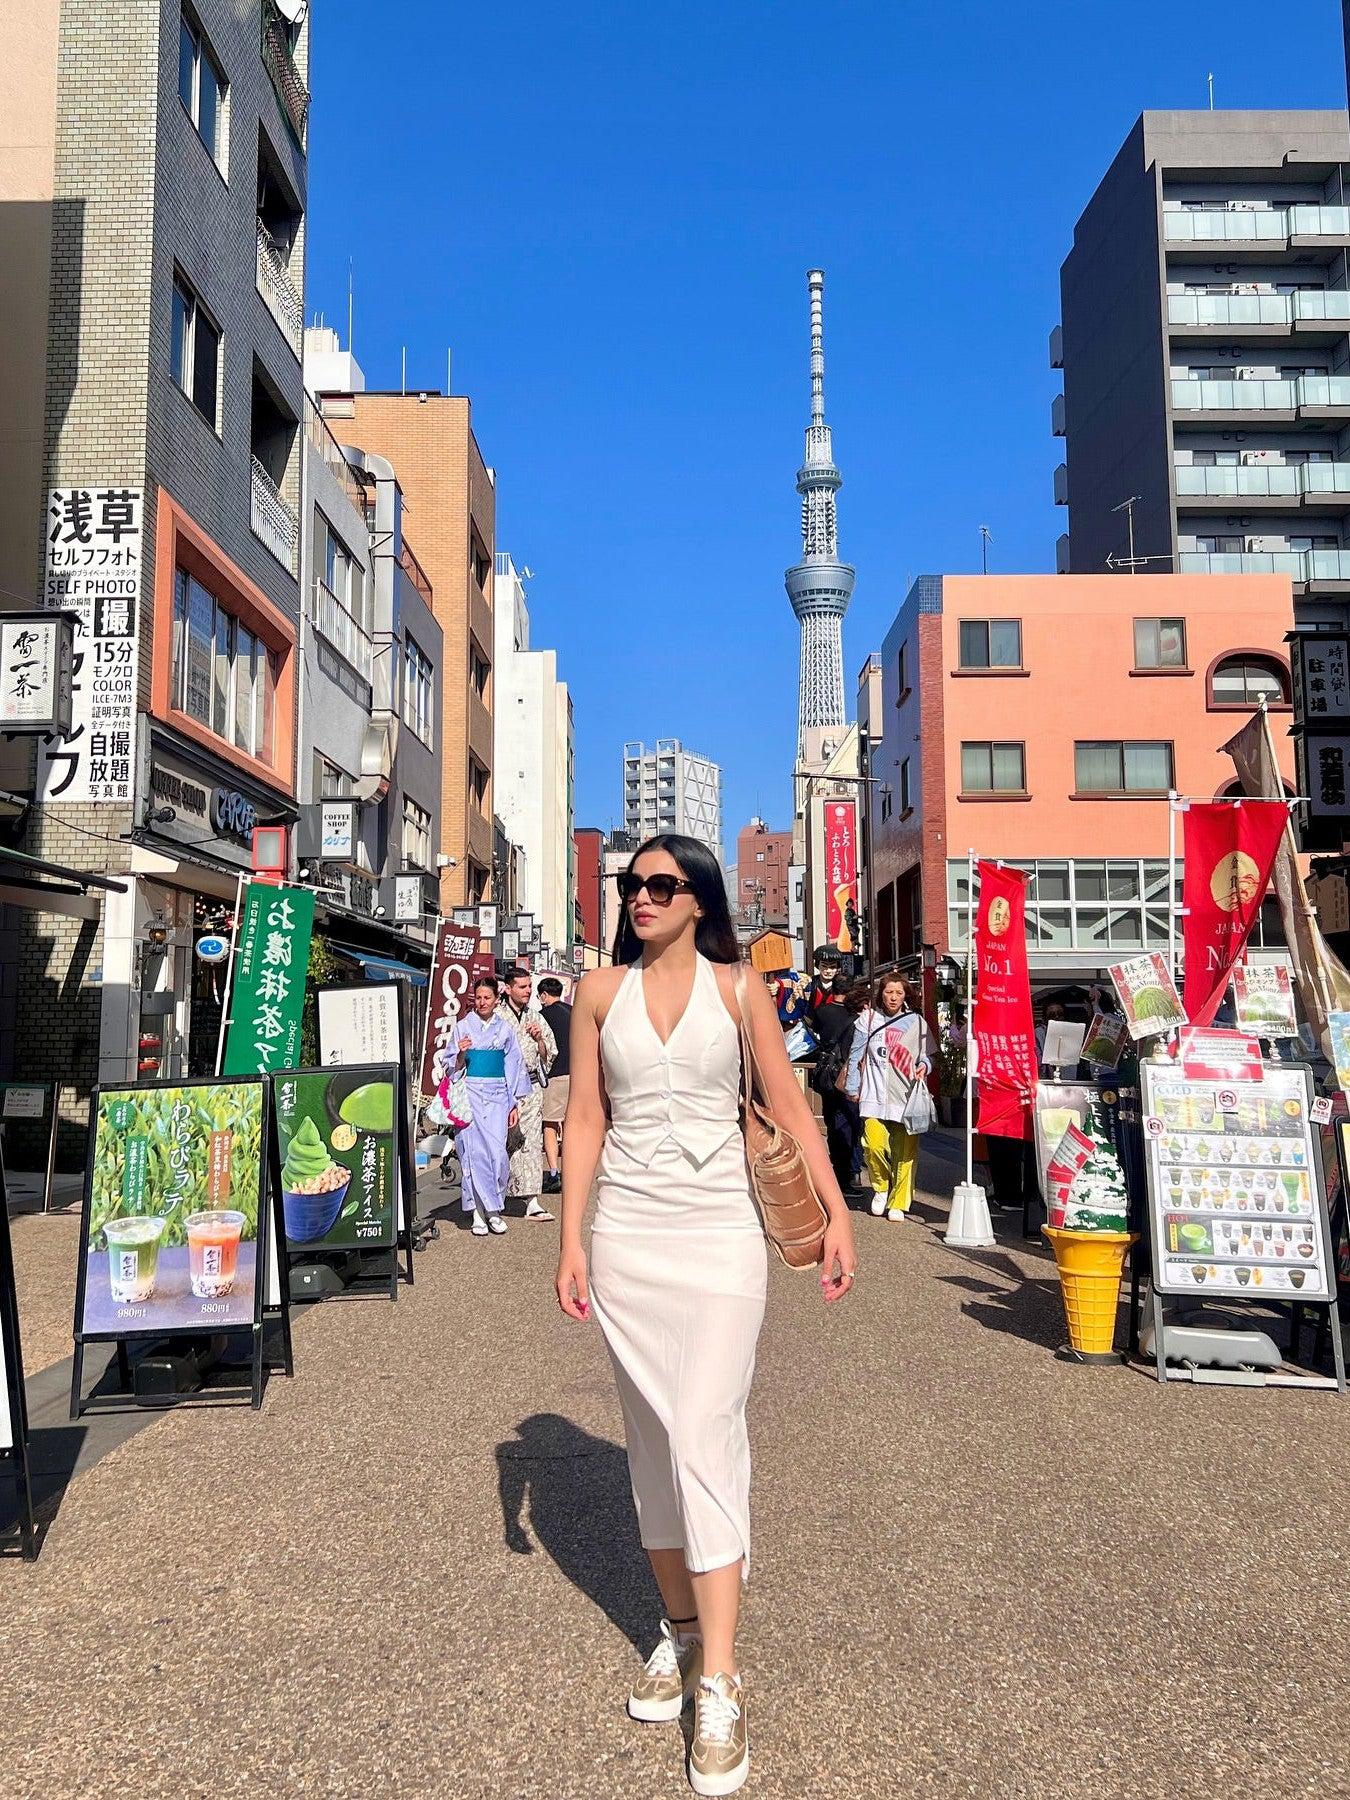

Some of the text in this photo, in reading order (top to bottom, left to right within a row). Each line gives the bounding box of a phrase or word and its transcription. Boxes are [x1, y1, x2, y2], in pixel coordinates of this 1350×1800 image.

[49, 489, 140, 544] 浅草
[48, 547, 137, 566] セルフフォト
[47, 579, 136, 595] SELF PHOTO
[100, 599, 130, 636] 撮
[93, 641, 133, 663] 15分
[93, 665, 133, 678] モノクロ
[1328, 645, 1346, 707] 時間貸し
[93, 680, 132, 692] COLOR
[1308, 658, 1328, 713] 駐車場
[92, 694, 132, 704] ILCE-7M3
[91, 706, 132, 719] 証明写真
[91, 721, 131, 730] 全データ付き
[90, 731, 130, 757] 自撮
[89, 758, 129, 783] 放題
[88, 784, 128, 798] 写真館
[1214, 922, 1246, 935] JAAN
[986, 941, 1007, 952] JAPAN
[984, 954, 1013, 976] No.1
[1124, 958, 1152, 975] 抹茶
[1245, 966, 1275, 978] 抹茶
[1157, 1087, 1191, 1095] COLD
[361, 1135, 377, 1218] お濃茶アイス
[356, 1226, 377, 1237] ¥750
[117, 1308, 142, 1318] 980円
[201, 1302, 226, 1313] 880円
